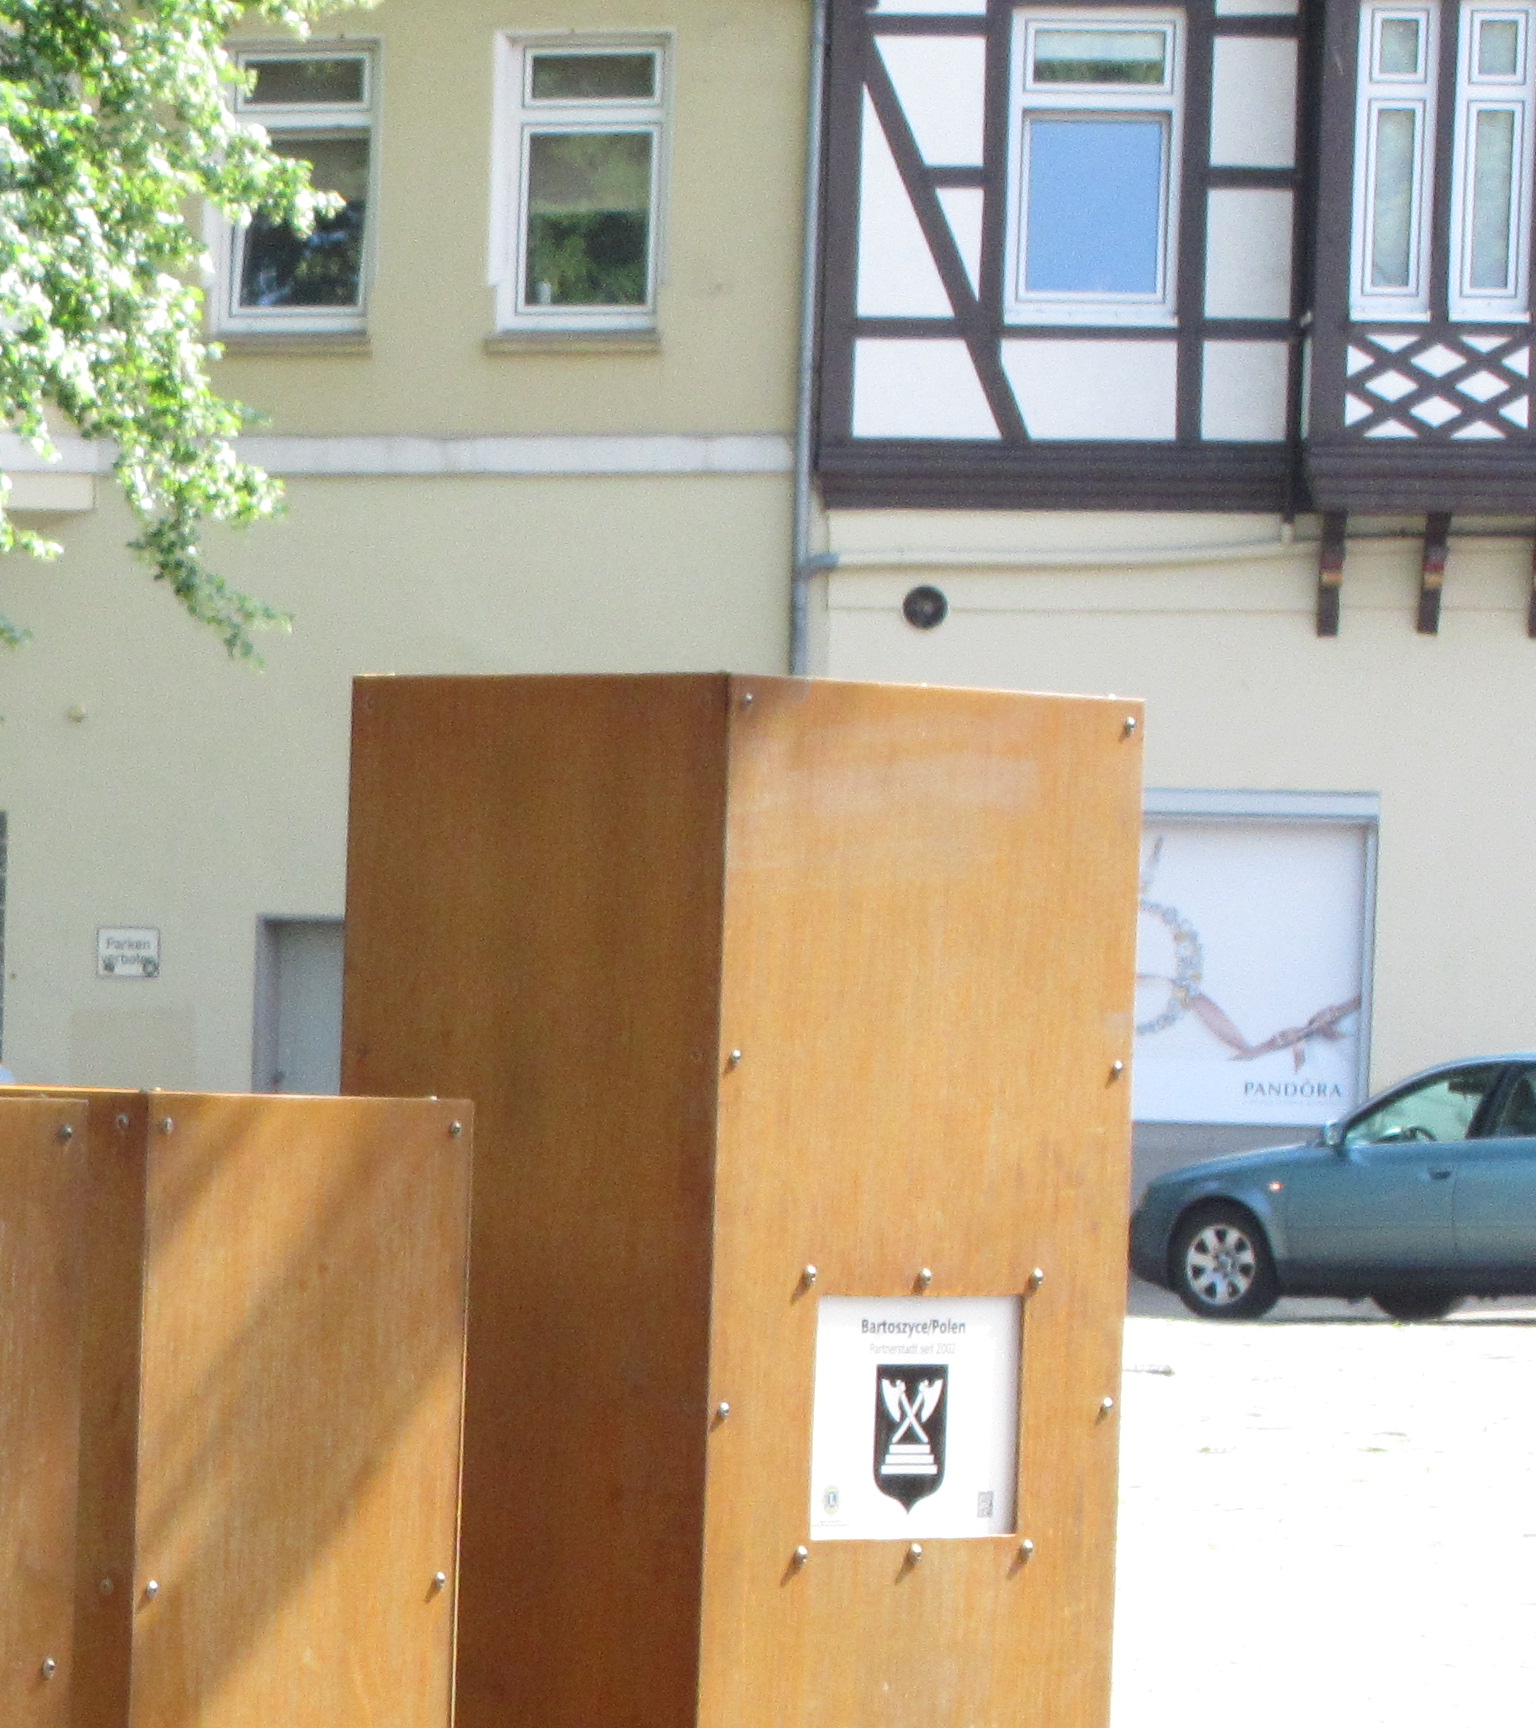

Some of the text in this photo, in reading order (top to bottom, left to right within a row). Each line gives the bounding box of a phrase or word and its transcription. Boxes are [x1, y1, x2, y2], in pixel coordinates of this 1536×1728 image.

[106, 937, 151, 951] Parken
[1244, 1081, 1342, 1097] PANDORA
[861, 1318, 966, 1338] Bartoszyce/Polen
